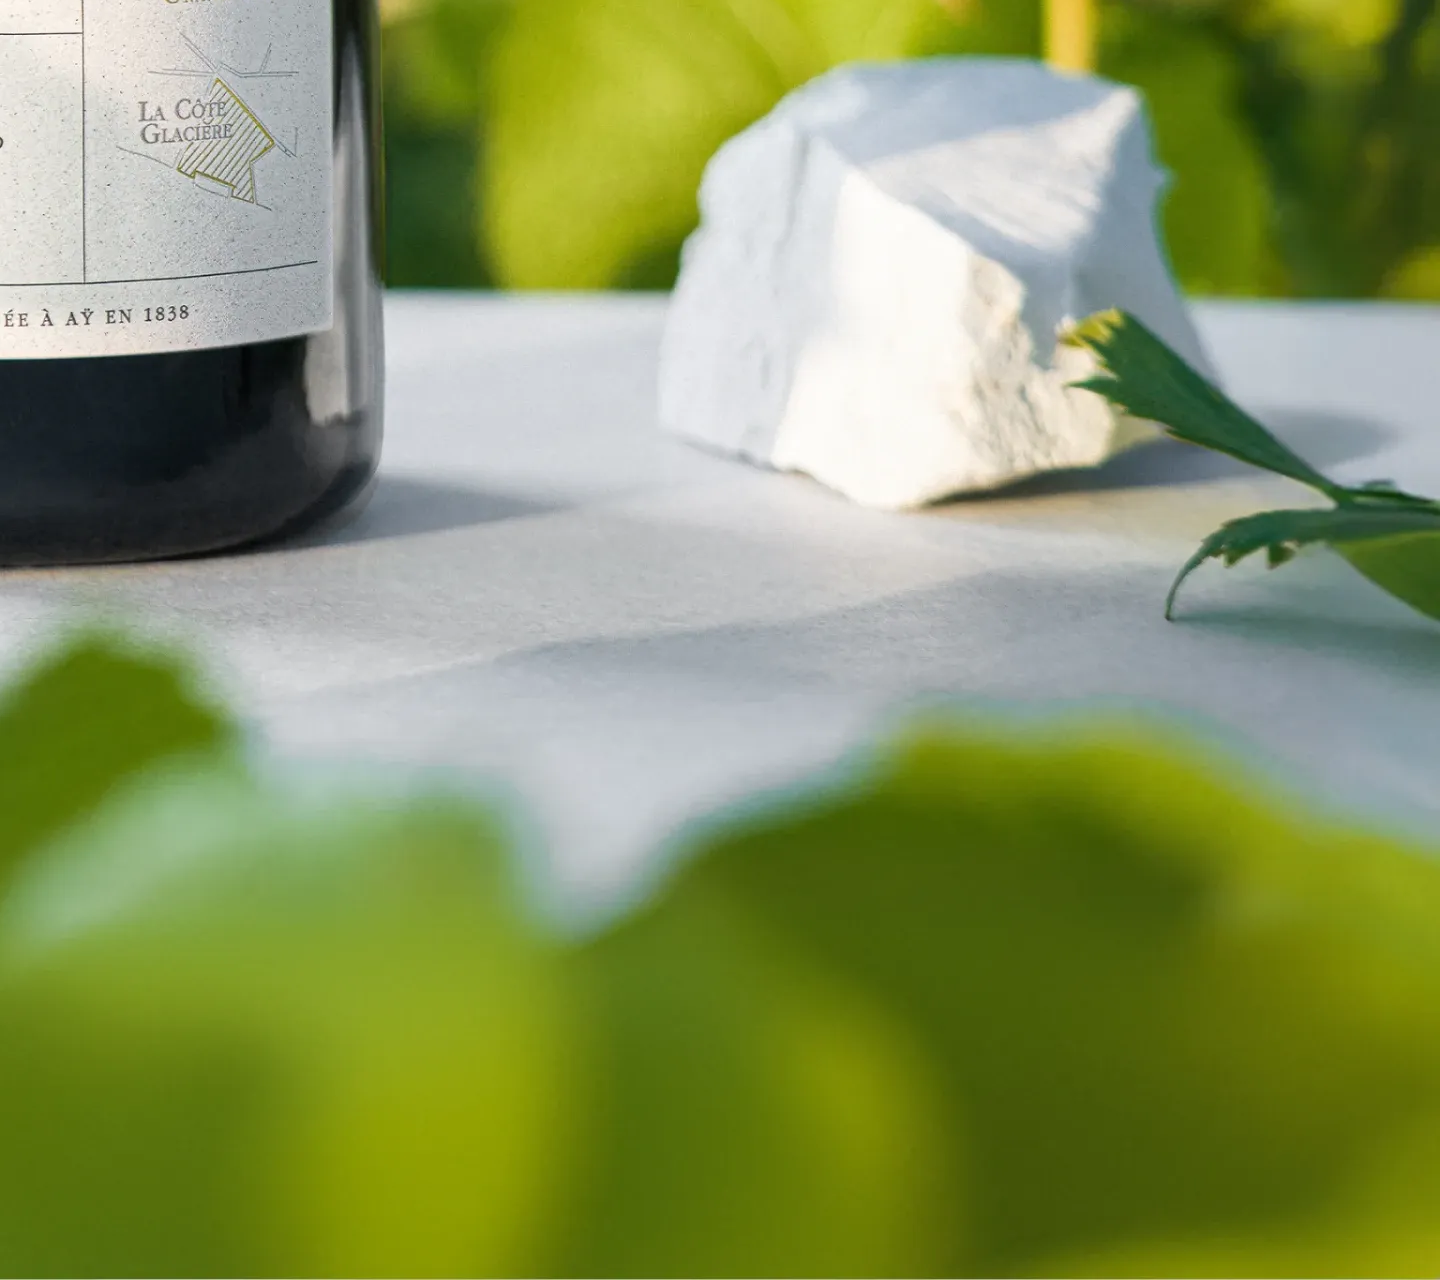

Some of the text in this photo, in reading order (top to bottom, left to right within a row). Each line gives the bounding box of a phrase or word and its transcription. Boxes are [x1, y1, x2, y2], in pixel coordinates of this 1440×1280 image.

[41, 308, 54, 327] À
[65, 308, 94, 326] AŸ
[105, 308, 132, 324] EN
[144, 305, 190, 322] 1838
